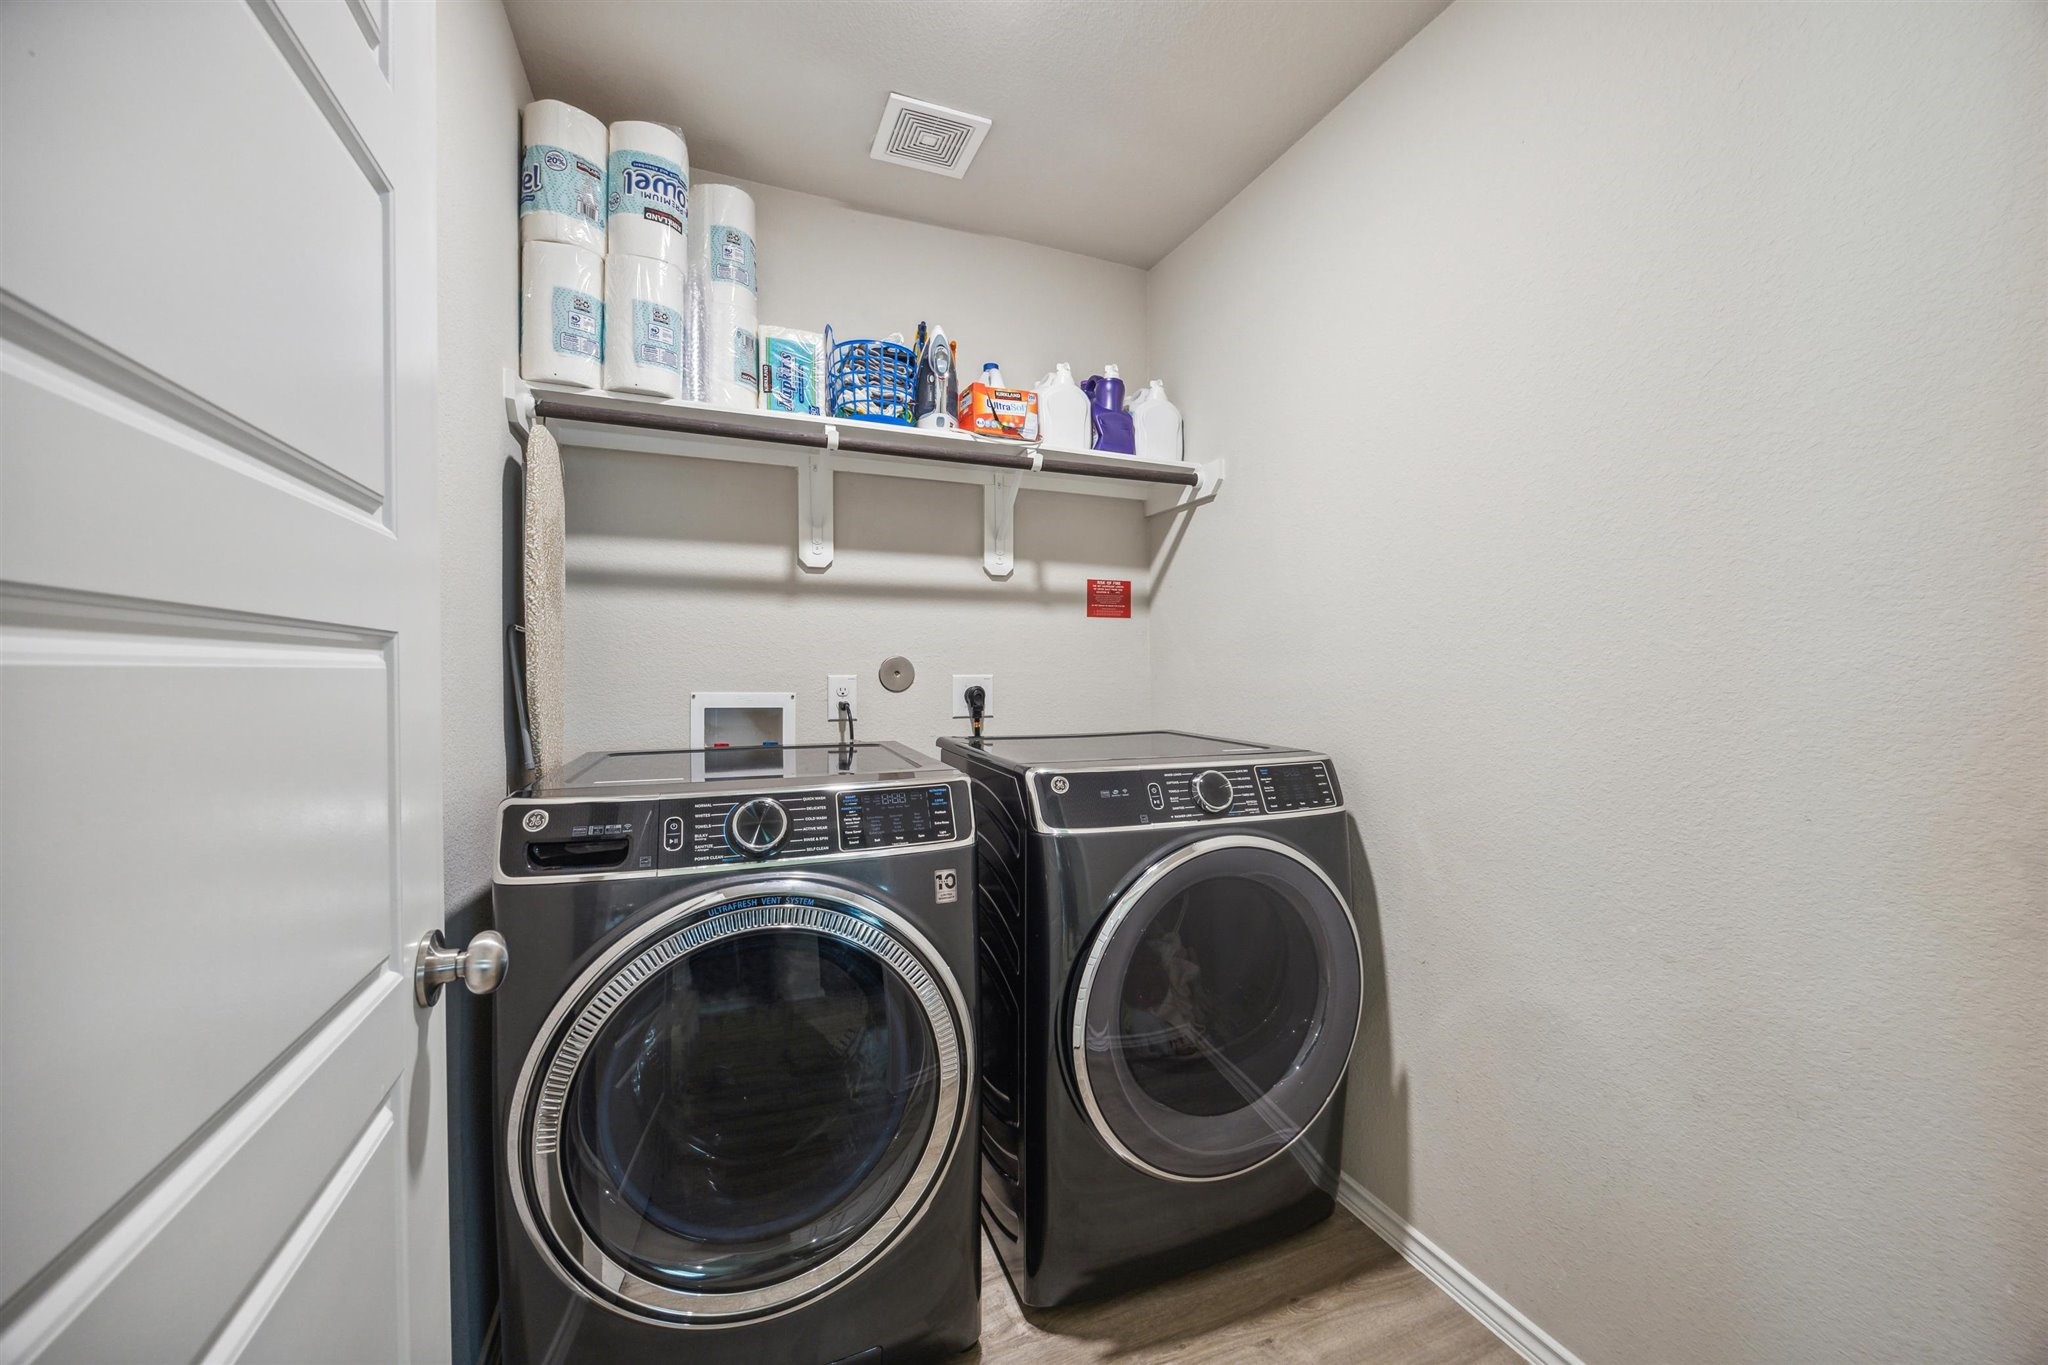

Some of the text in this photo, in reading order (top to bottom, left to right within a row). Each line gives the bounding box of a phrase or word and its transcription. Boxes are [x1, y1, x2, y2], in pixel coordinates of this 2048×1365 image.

[623, 169, 688, 211] owel
[996, 390, 1020, 398] KIRKLAND
[935, 872, 956, 890] 10
[708, 896, 815, 917] ULTRAFRESH VENT SYSTEM
